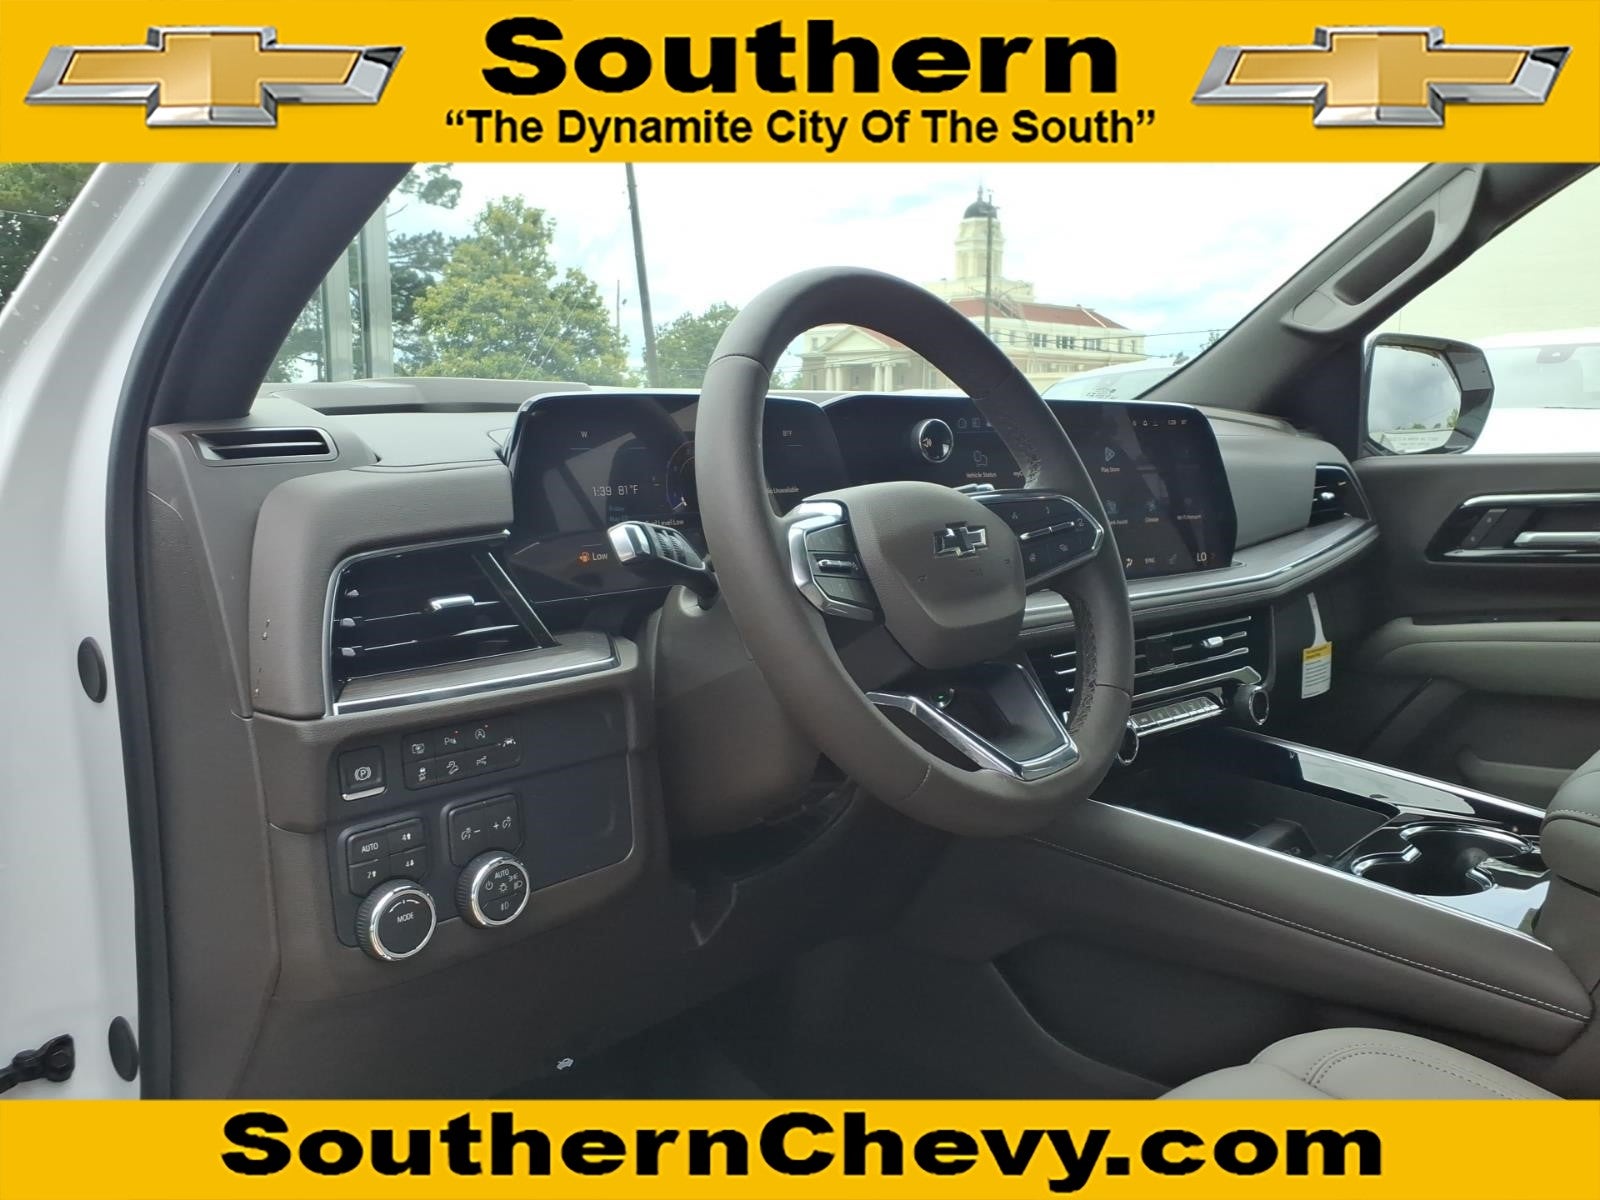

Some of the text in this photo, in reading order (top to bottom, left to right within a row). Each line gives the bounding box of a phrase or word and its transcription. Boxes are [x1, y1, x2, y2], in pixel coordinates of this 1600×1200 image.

[592, 486, 612, 497] 1:39
[592, 552, 608, 561] Low
[1196, 551, 1207, 562] LO
[361, 842, 379, 854] AUTO
[494, 868, 510, 879] AUTO
[396, 911, 414, 923] MODE
